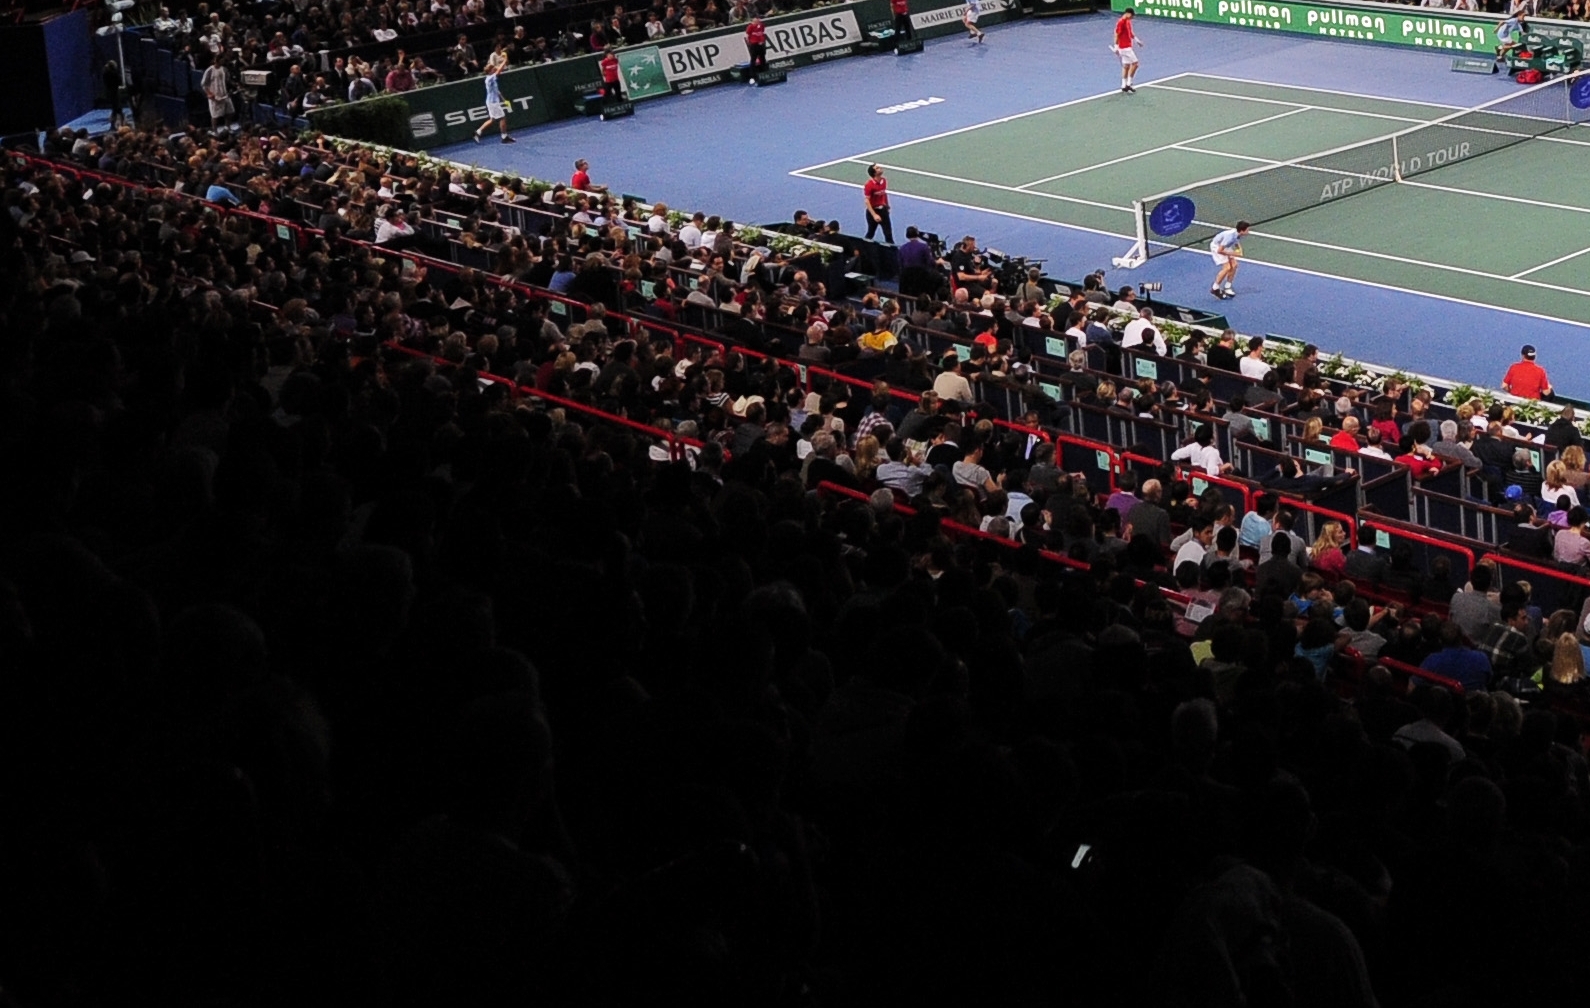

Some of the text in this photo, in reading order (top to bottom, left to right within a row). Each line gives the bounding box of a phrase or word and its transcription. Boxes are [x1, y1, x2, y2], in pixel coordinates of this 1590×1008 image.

[920, 10, 953, 24] MAIRIE
[1145, 8, 1193, 20] HOTELS
[1218, 0, 1291, 24] pullman
[1307, 9, 1385, 34] pullman
[1229, 16, 1281, 29] HOTELS
[1402, 19, 1485, 45] pullman
[1319, 27, 1374, 40] HOTELS
[668, 18, 847, 74] BNP ARIBAS
[1415, 37, 1473, 50] HOTELS
[1320, 178, 1352, 202] ATP
[1427, 141, 1470, 167] TOUR
